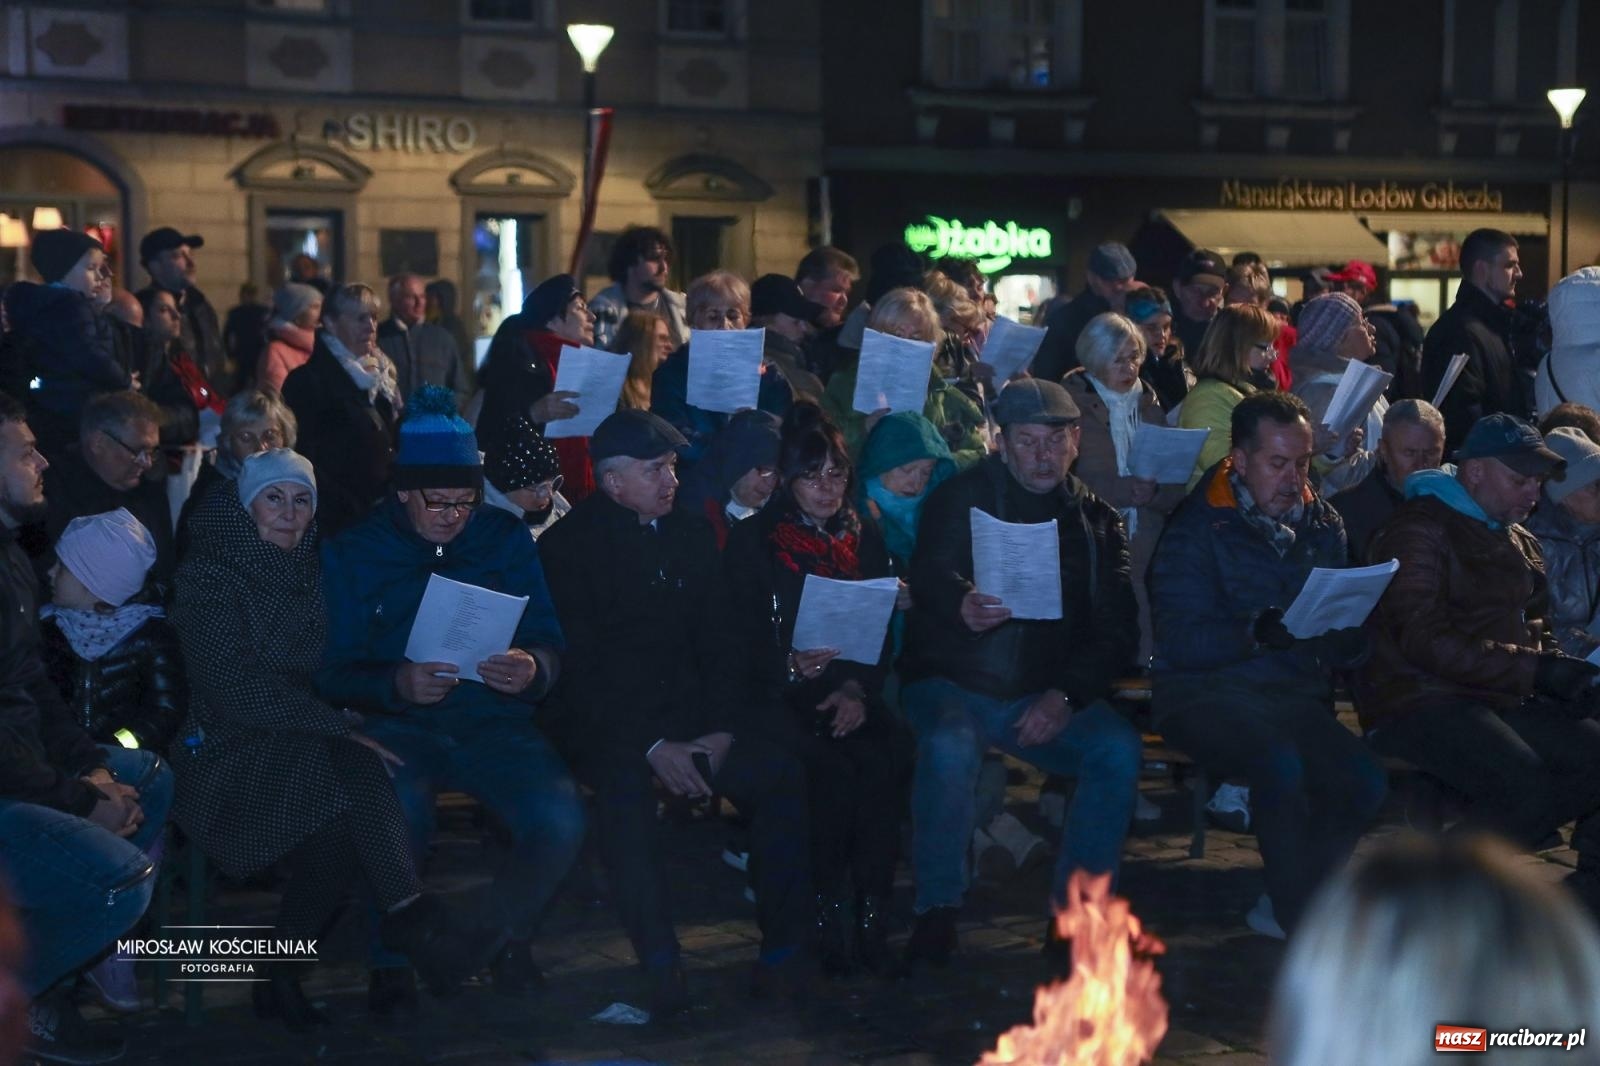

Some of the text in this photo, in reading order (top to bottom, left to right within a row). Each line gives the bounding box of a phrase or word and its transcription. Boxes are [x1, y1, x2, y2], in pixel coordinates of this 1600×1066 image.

[347, 112, 477, 153] SHIRO
[1221, 179, 1344, 210] Manufaktura
[1350, 179, 1416, 210] Lodów
